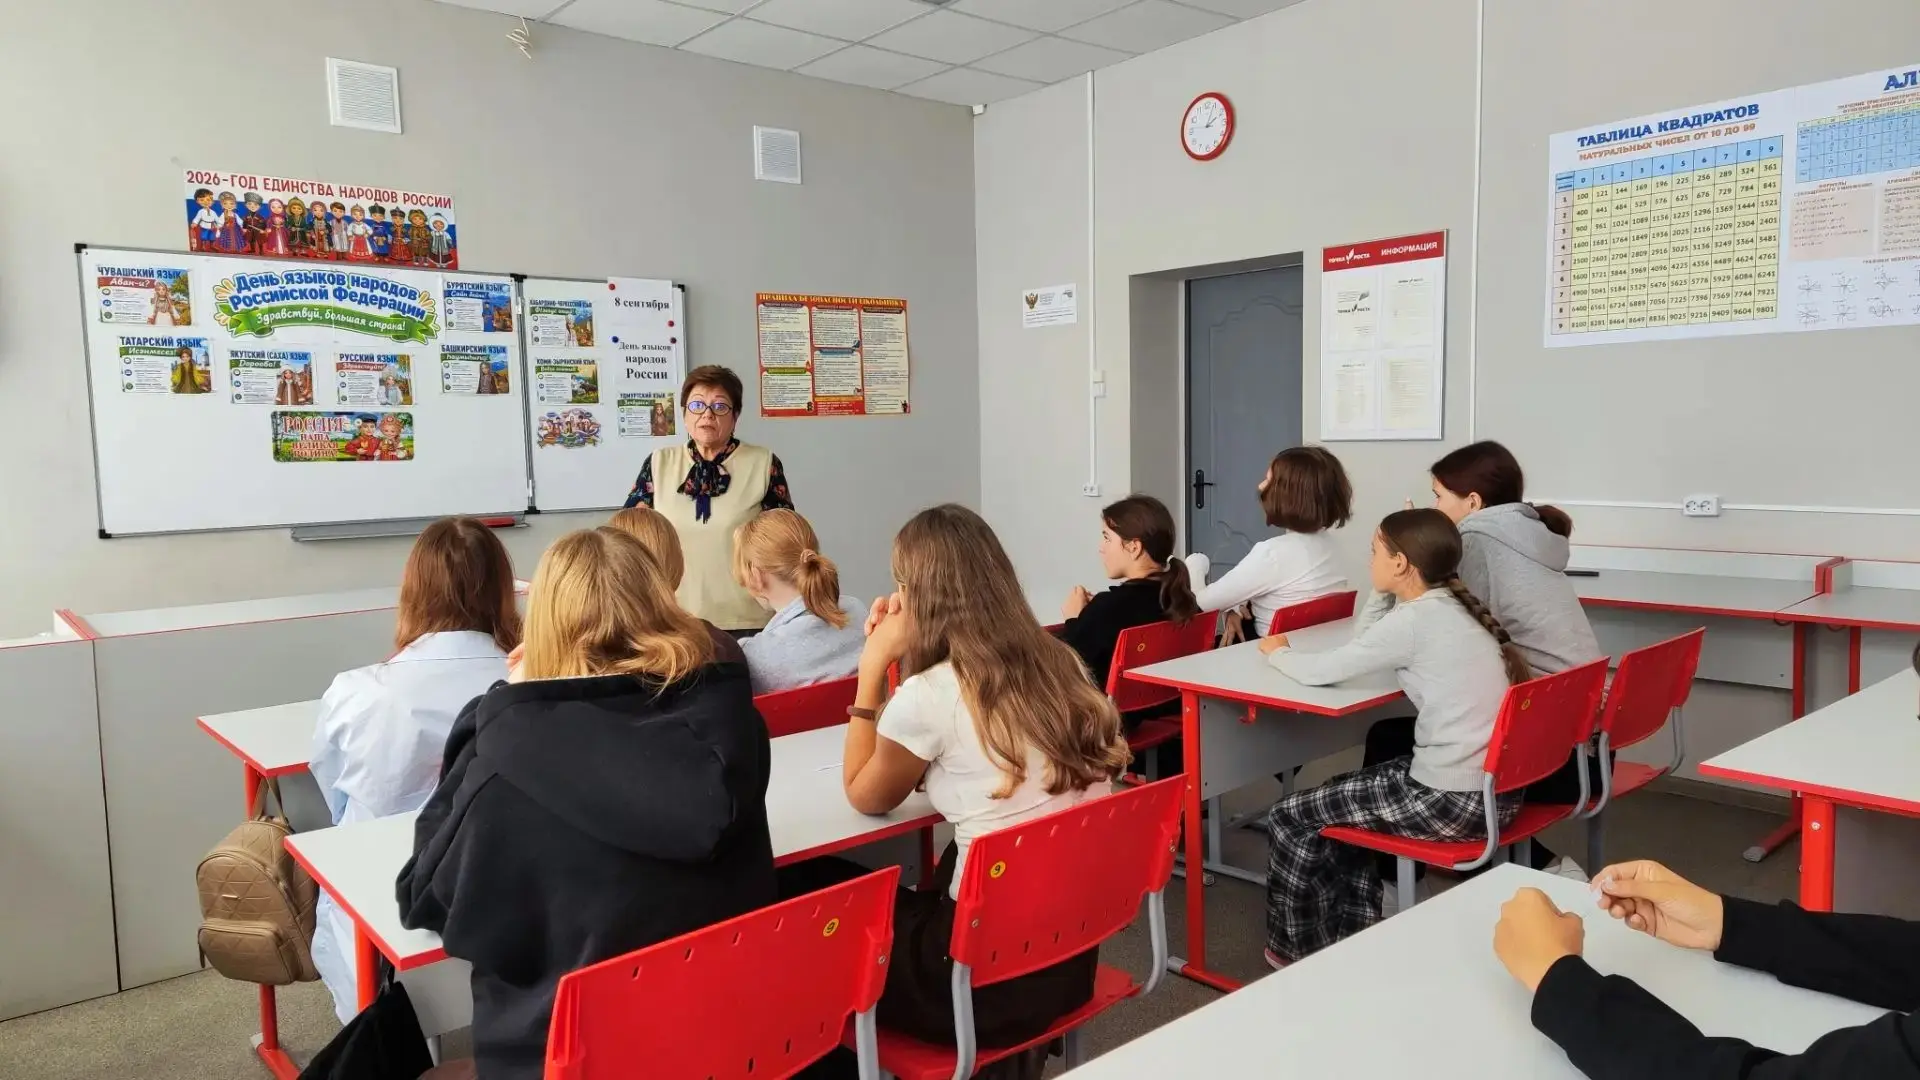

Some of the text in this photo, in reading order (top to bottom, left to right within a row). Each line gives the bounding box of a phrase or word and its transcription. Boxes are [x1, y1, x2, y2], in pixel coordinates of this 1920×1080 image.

[1884, 70, 1920, 91] АЛ
[1577, 104, 1760, 147] ТАБЛИЦА КВАДРАТОВ
[1579, 122, 1756, 161] НАТУРАЛЬНЫХ ЧИСЕЛ ОТ 10 ДО 99
[187, 171, 452, 209] 2026-ГОД ЕДИНСТВА НАРОДОВ РОССИИ
[1381, 242, 1438, 256] ИНФОРМАЦИЯ
[98, 267, 181, 279] ЧУВАШСКИЙ ЯЗЫК
[110, 278, 150, 287] Аван-и?
[236, 273, 417, 301] День языков народов
[447, 282, 484, 290] БУРЯТСКИЙ
[229, 286, 329, 310] Российской
[333, 287, 426, 320] Федерации
[615, 297, 669, 311] 8 сентября
[256, 308, 406, 331] Здравствуй, большая страна!
[120, 336, 202, 347] ТАТАРСКИЙ ЯЗЫК
[619, 342, 640, 350] День
[441, 345, 486, 353] БАШКИРСКИЙ
[230, 351, 266, 359] ЯКУТСКИЙ
[267, 351, 288, 360] (САХА)
[339, 353, 398, 363] РУССКИЙ ЯЗЫК
[625, 355, 667, 365] народов
[626, 368, 668, 379] России
